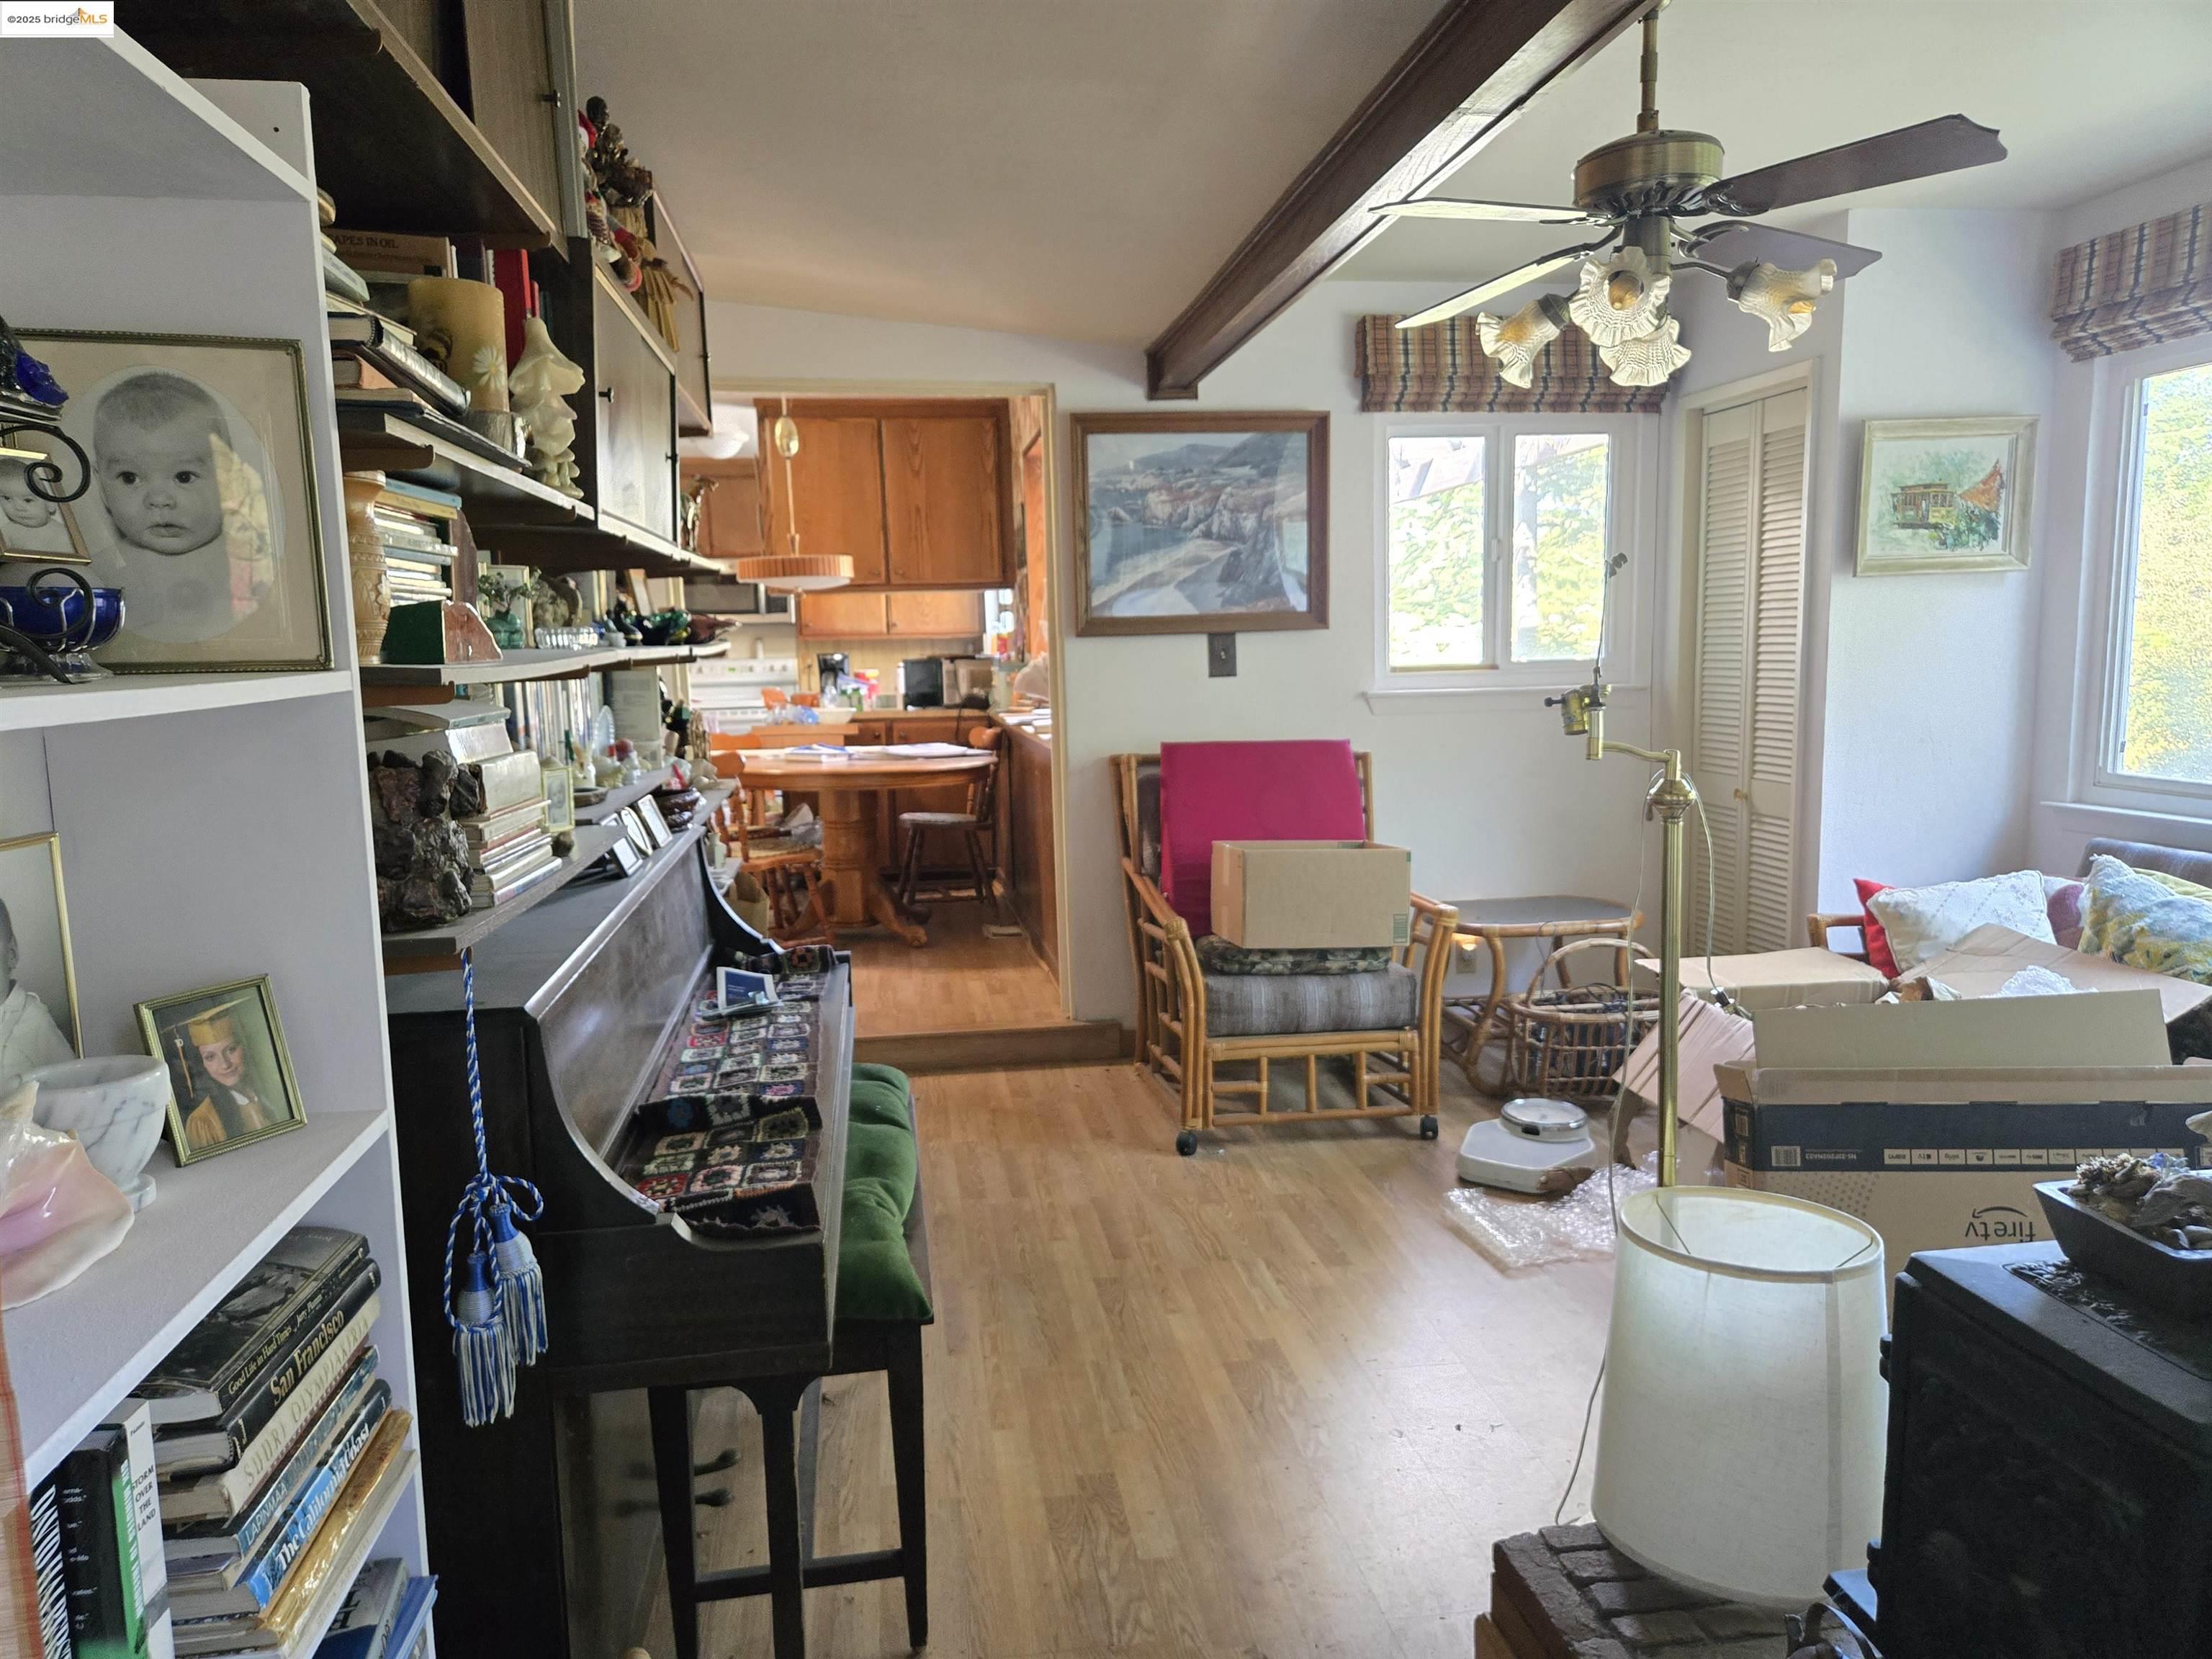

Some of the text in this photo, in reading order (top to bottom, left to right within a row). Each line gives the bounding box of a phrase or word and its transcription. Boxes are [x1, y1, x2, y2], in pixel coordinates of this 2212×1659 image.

[331, 234, 398, 248] APES IN OIL
[228, 1372, 246, 1395] Good
[245, 1362, 257, 1380] Life
[262, 1336, 277, 1359] Hard
[270, 1367, 295, 1405] San
[294, 1310, 345, 1377] Francisco
[135, 1481, 153, 1503] OVER
[140, 1498, 152, 1515] THE
[275, 1534, 300, 1570] The
[297, 1458, 346, 1539] California
[343, 1423, 370, 1469] Coast
[30, 1484, 60, 1571] DAVID
[138, 1509, 156, 1532] LAND
